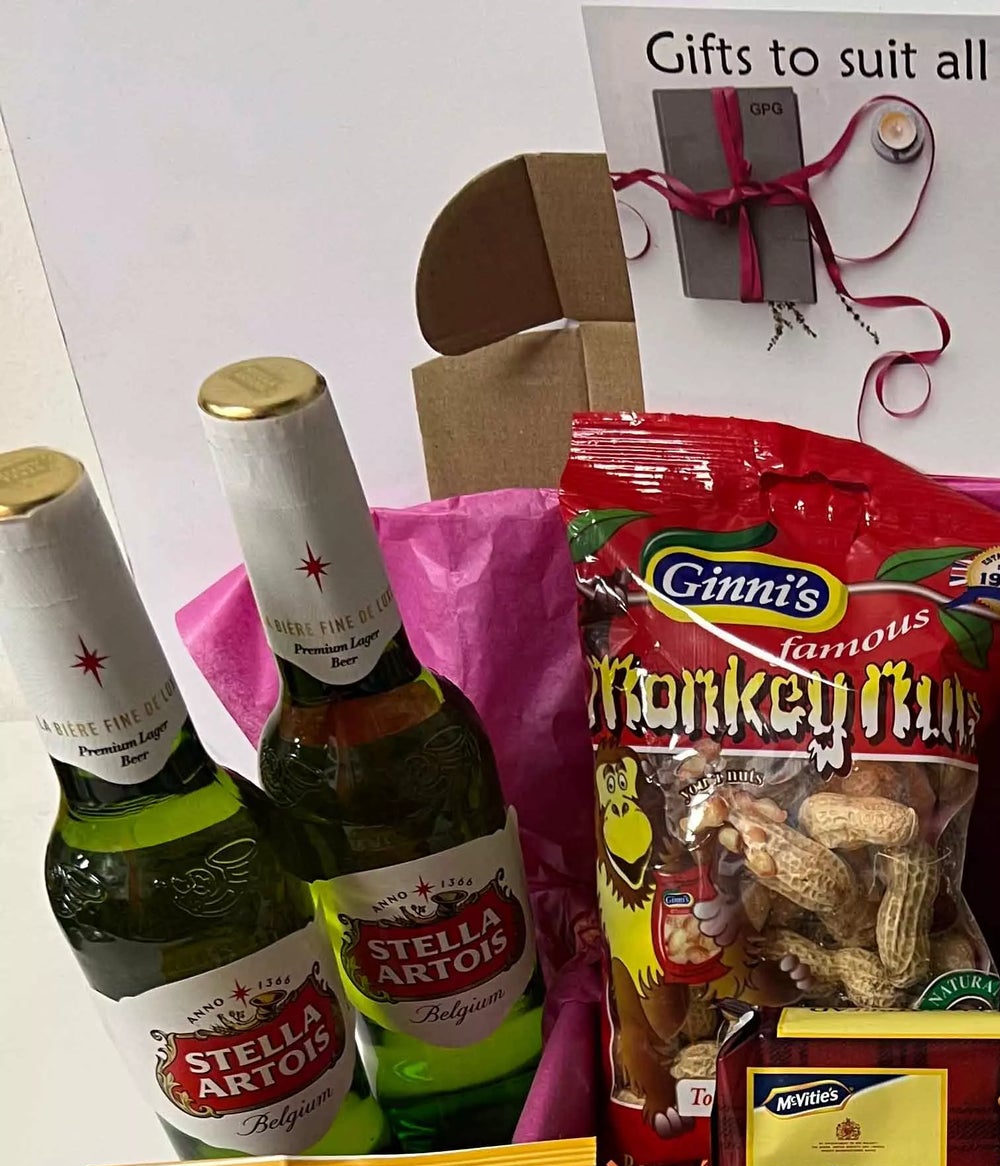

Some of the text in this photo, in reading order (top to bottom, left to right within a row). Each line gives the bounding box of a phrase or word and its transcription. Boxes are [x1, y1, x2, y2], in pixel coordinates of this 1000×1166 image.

[647, 30, 752, 76] Gifts
[770, 40, 819, 78] to
[840, 41, 917, 79] suit
[936, 41, 987, 80] all
[750, 103, 783, 117] GPG
[662, 560, 821, 614] Ginni's
[779, 608, 930, 662] famous
[78, 720, 168, 757] Premium Lager
[104, 709, 142, 733] FINE
[121, 750, 149, 767] Beer
[727, 768, 765, 787] nuts
[372, 891, 408, 913] ANNO
[368, 908, 502, 960] STELLA
[377, 928, 509, 985] ARTOIS
[186, 997, 225, 1025] ANNO
[409, 986, 505, 1026] Belgium
[185, 1003, 323, 1075] STELLA
[198, 1029, 331, 1099] ARTOIS
[236, 1087, 334, 1136] Belgium
[776, 1087, 838, 1111] McVitie's
